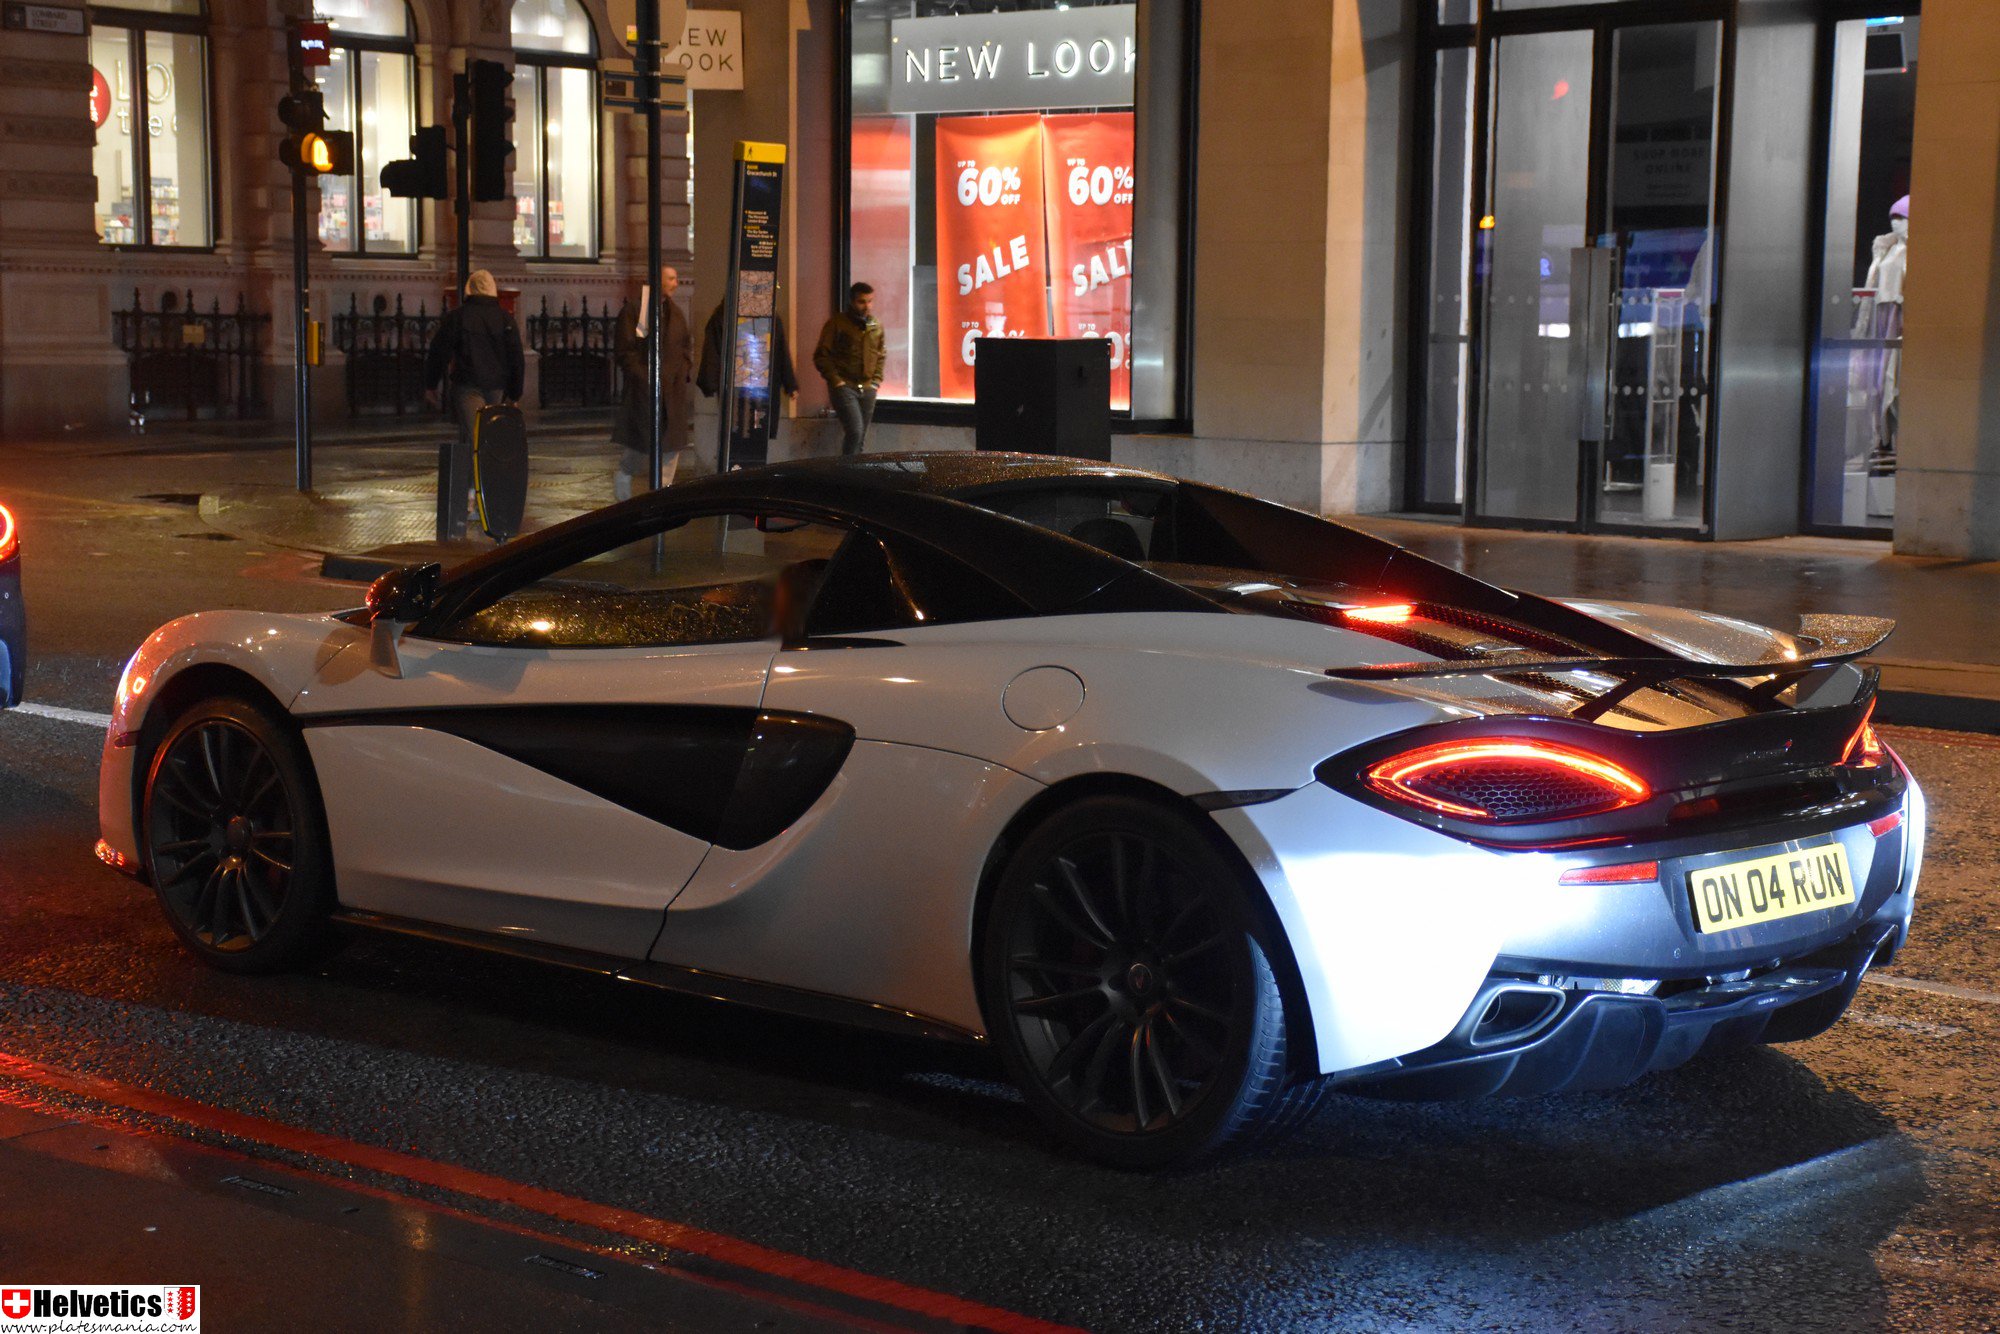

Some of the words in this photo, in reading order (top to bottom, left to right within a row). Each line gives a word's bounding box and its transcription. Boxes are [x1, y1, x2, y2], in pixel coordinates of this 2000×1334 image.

[679, 28, 727, 46] EW
[662, 52, 733, 71] OOK
[906, 44, 1002, 83] NEW
[967, 160, 975, 168] TO
[1067, 158, 1076, 166] UP
[1077, 158, 1085, 167] TO
[957, 166, 1021, 206] 60%
[1068, 166, 1134, 206] 60%
[1001, 194, 1021, 205] OFF
[957, 235, 1030, 296] SALE
[971, 321, 980, 329] TO
[1789, 853, 1845, 904] RUN
